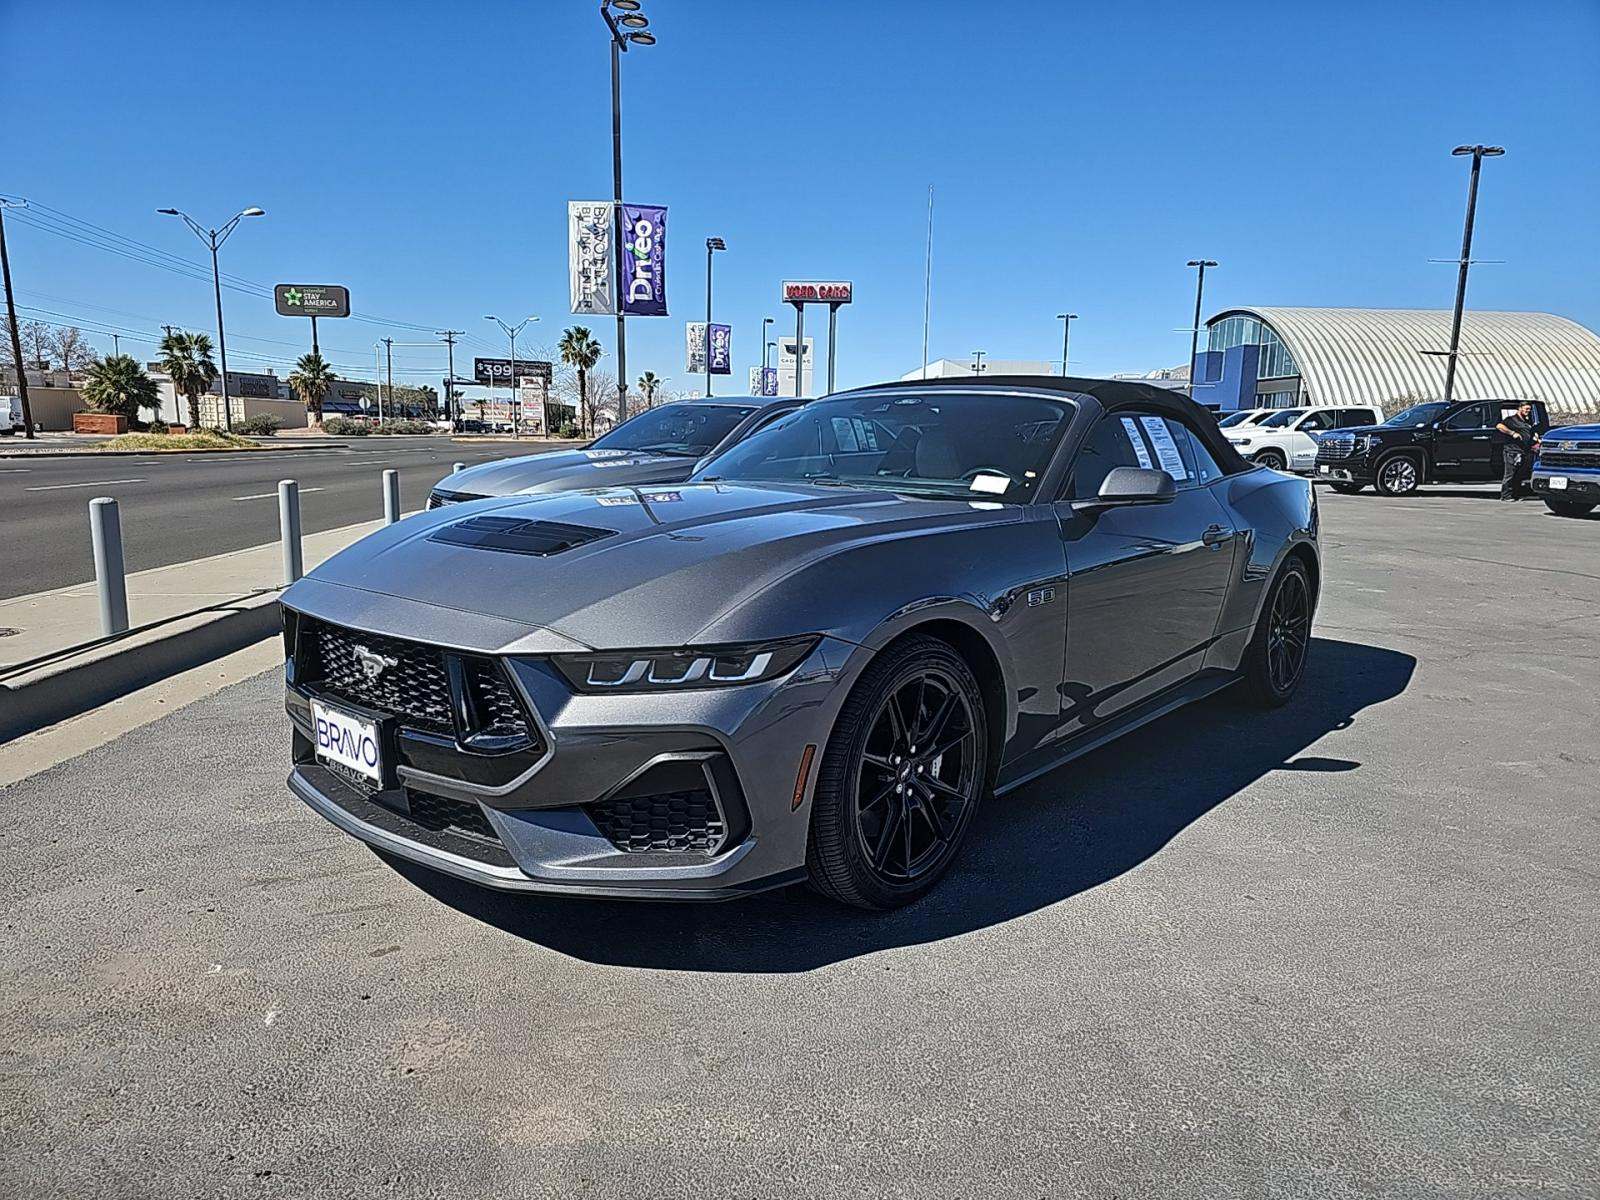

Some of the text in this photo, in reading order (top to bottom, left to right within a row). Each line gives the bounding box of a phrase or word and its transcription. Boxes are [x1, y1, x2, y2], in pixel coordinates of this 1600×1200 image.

[581, 258, 593, 309] CENTER
[477, 362, 512, 376] $399
[317, 717, 378, 768] BRAVO
